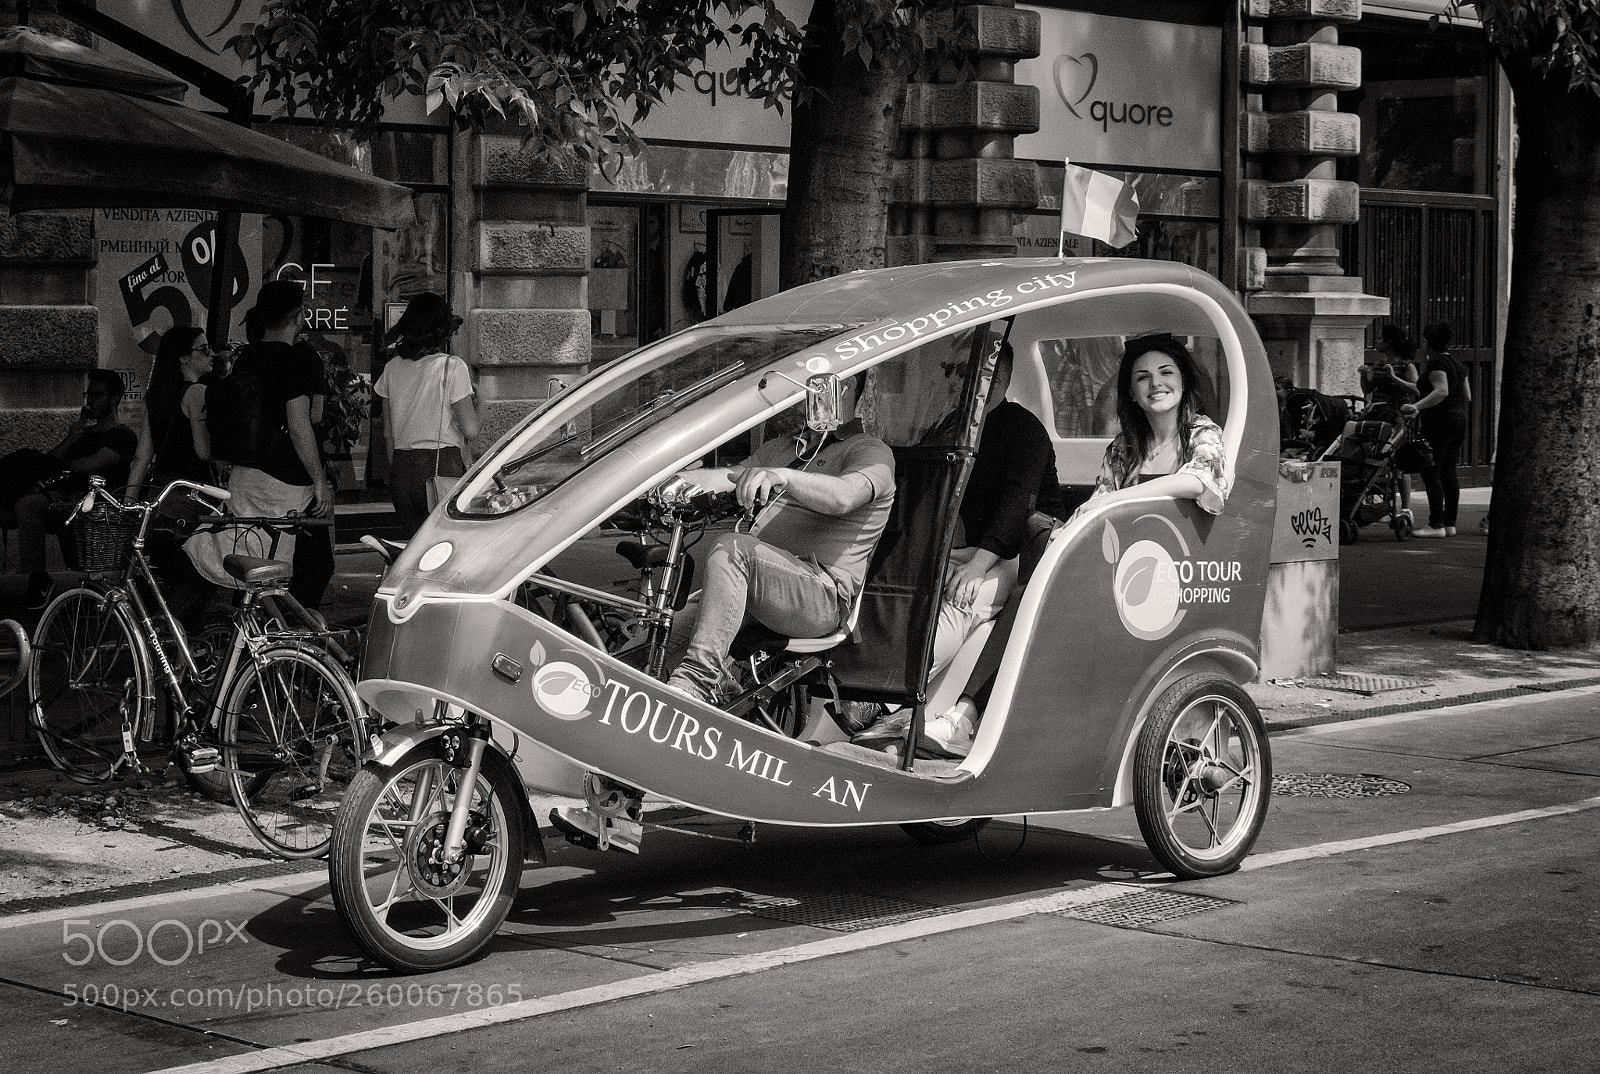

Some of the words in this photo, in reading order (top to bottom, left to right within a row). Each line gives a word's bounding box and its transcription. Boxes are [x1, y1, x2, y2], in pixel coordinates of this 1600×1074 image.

[1090, 101, 1173, 132] quore
[103, 207, 160, 222] VENDITA
[1034, 238, 1079, 249] AZIENALE
[127, 269, 149, 293] fino
[149, 257, 162, 275] al
[1016, 270, 1077, 294] city
[1156, 560, 1194, 583] ECO
[1196, 561, 1242, 582] TOUR
[1165, 588, 1231, 603] SHOPPING
[598, 678, 723, 761] TOURS
